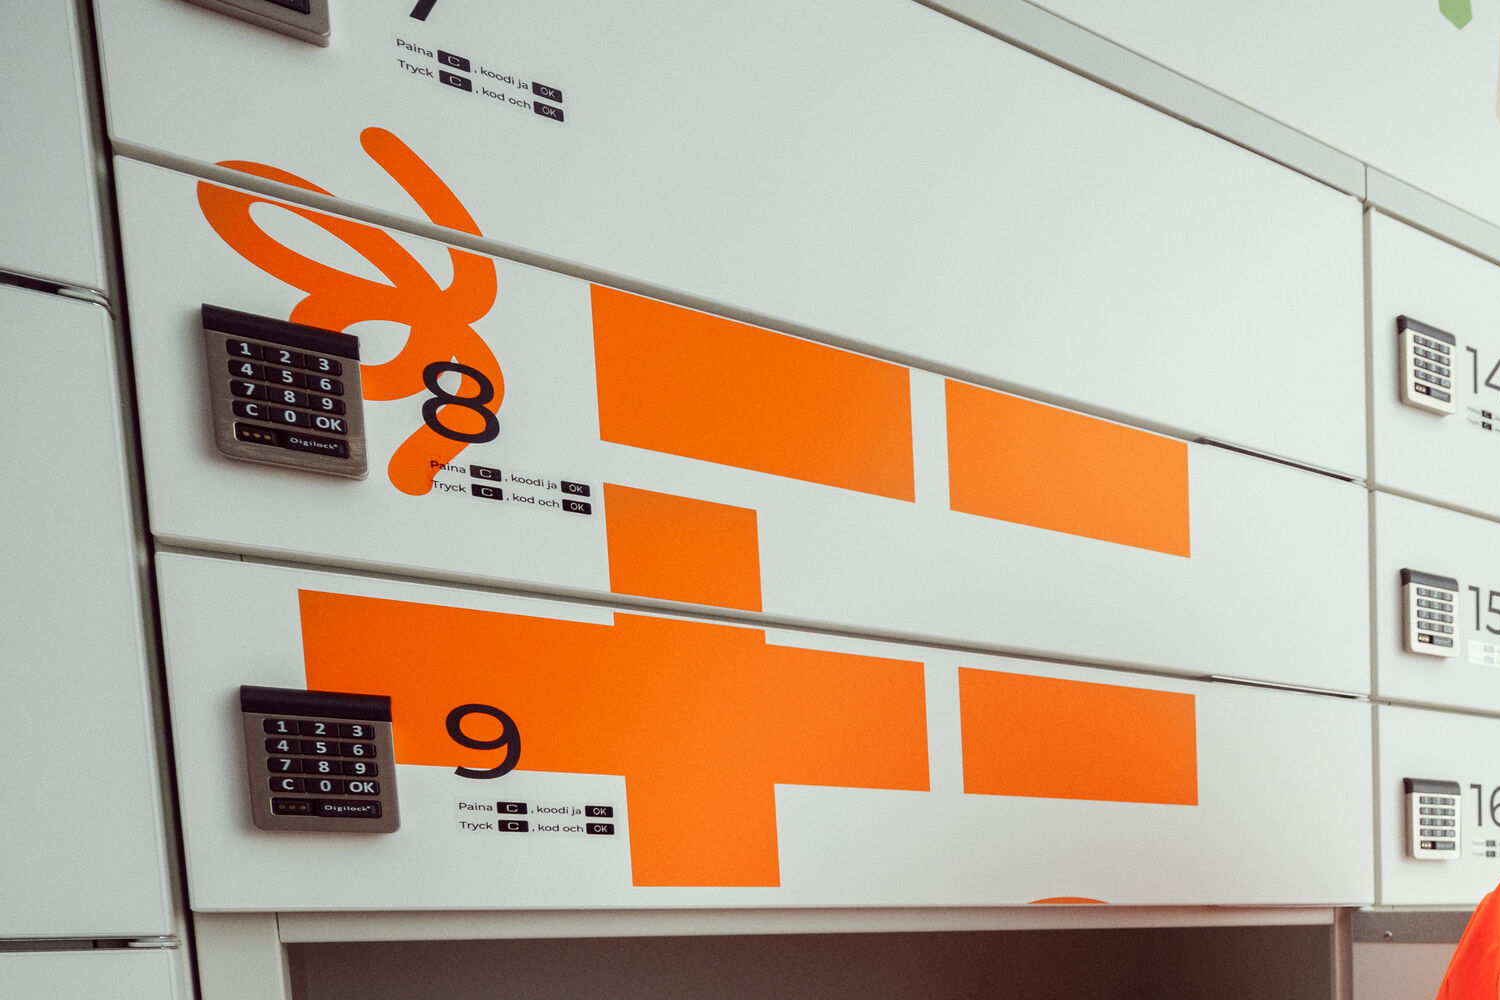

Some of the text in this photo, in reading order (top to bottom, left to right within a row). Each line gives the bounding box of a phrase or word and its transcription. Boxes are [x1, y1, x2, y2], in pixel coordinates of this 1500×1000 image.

[396, 38, 434, 59] Paina
[447, 56, 460, 68] C
[480, 66, 515, 85] koodi
[517, 79, 529, 90] ja
[540, 86, 556, 99] OK
[397, 59, 434, 78] Tryck
[449, 76, 462, 87] C
[482, 87, 505, 101] kod
[508, 97, 531, 110] och
[541, 106, 557, 118] OK
[240, 343, 330, 371] 1 2 3
[241, 363, 332, 391] 4 5 6
[243, 382, 333, 410] 7 8 9
[422, 361, 500, 444] 8
[246, 404, 342, 432] C 0 OK
[430, 460, 466, 474] Paina
[479, 469, 492, 478] C
[511, 474, 544, 487] koodi
[546, 480, 558, 490] ja
[568, 483, 583, 493] OK
[432, 480, 466, 493] Tryck
[481, 488, 493, 497] C
[512, 493, 535, 504] kod
[538, 499, 560, 508] och
[570, 502, 584, 512] OK
[277, 720, 363, 737] 1 2 3
[445, 703, 522, 780] 9
[277, 740, 364, 756] 4 5 6
[280, 759, 366, 774] 7 8 9
[282, 779, 375, 793] C 0 OK
[458, 802, 493, 812] Paina
[506, 804, 518, 813] C
[536, 805, 569, 814] koodi
[571, 806, 582, 816] ja
[592, 808, 607, 816] OK
[459, 821, 493, 831] Tryck
[507, 822, 519, 830] C
[538, 824, 560, 832] kod
[562, 825, 584, 833] och
[593, 825, 608, 833] OK
